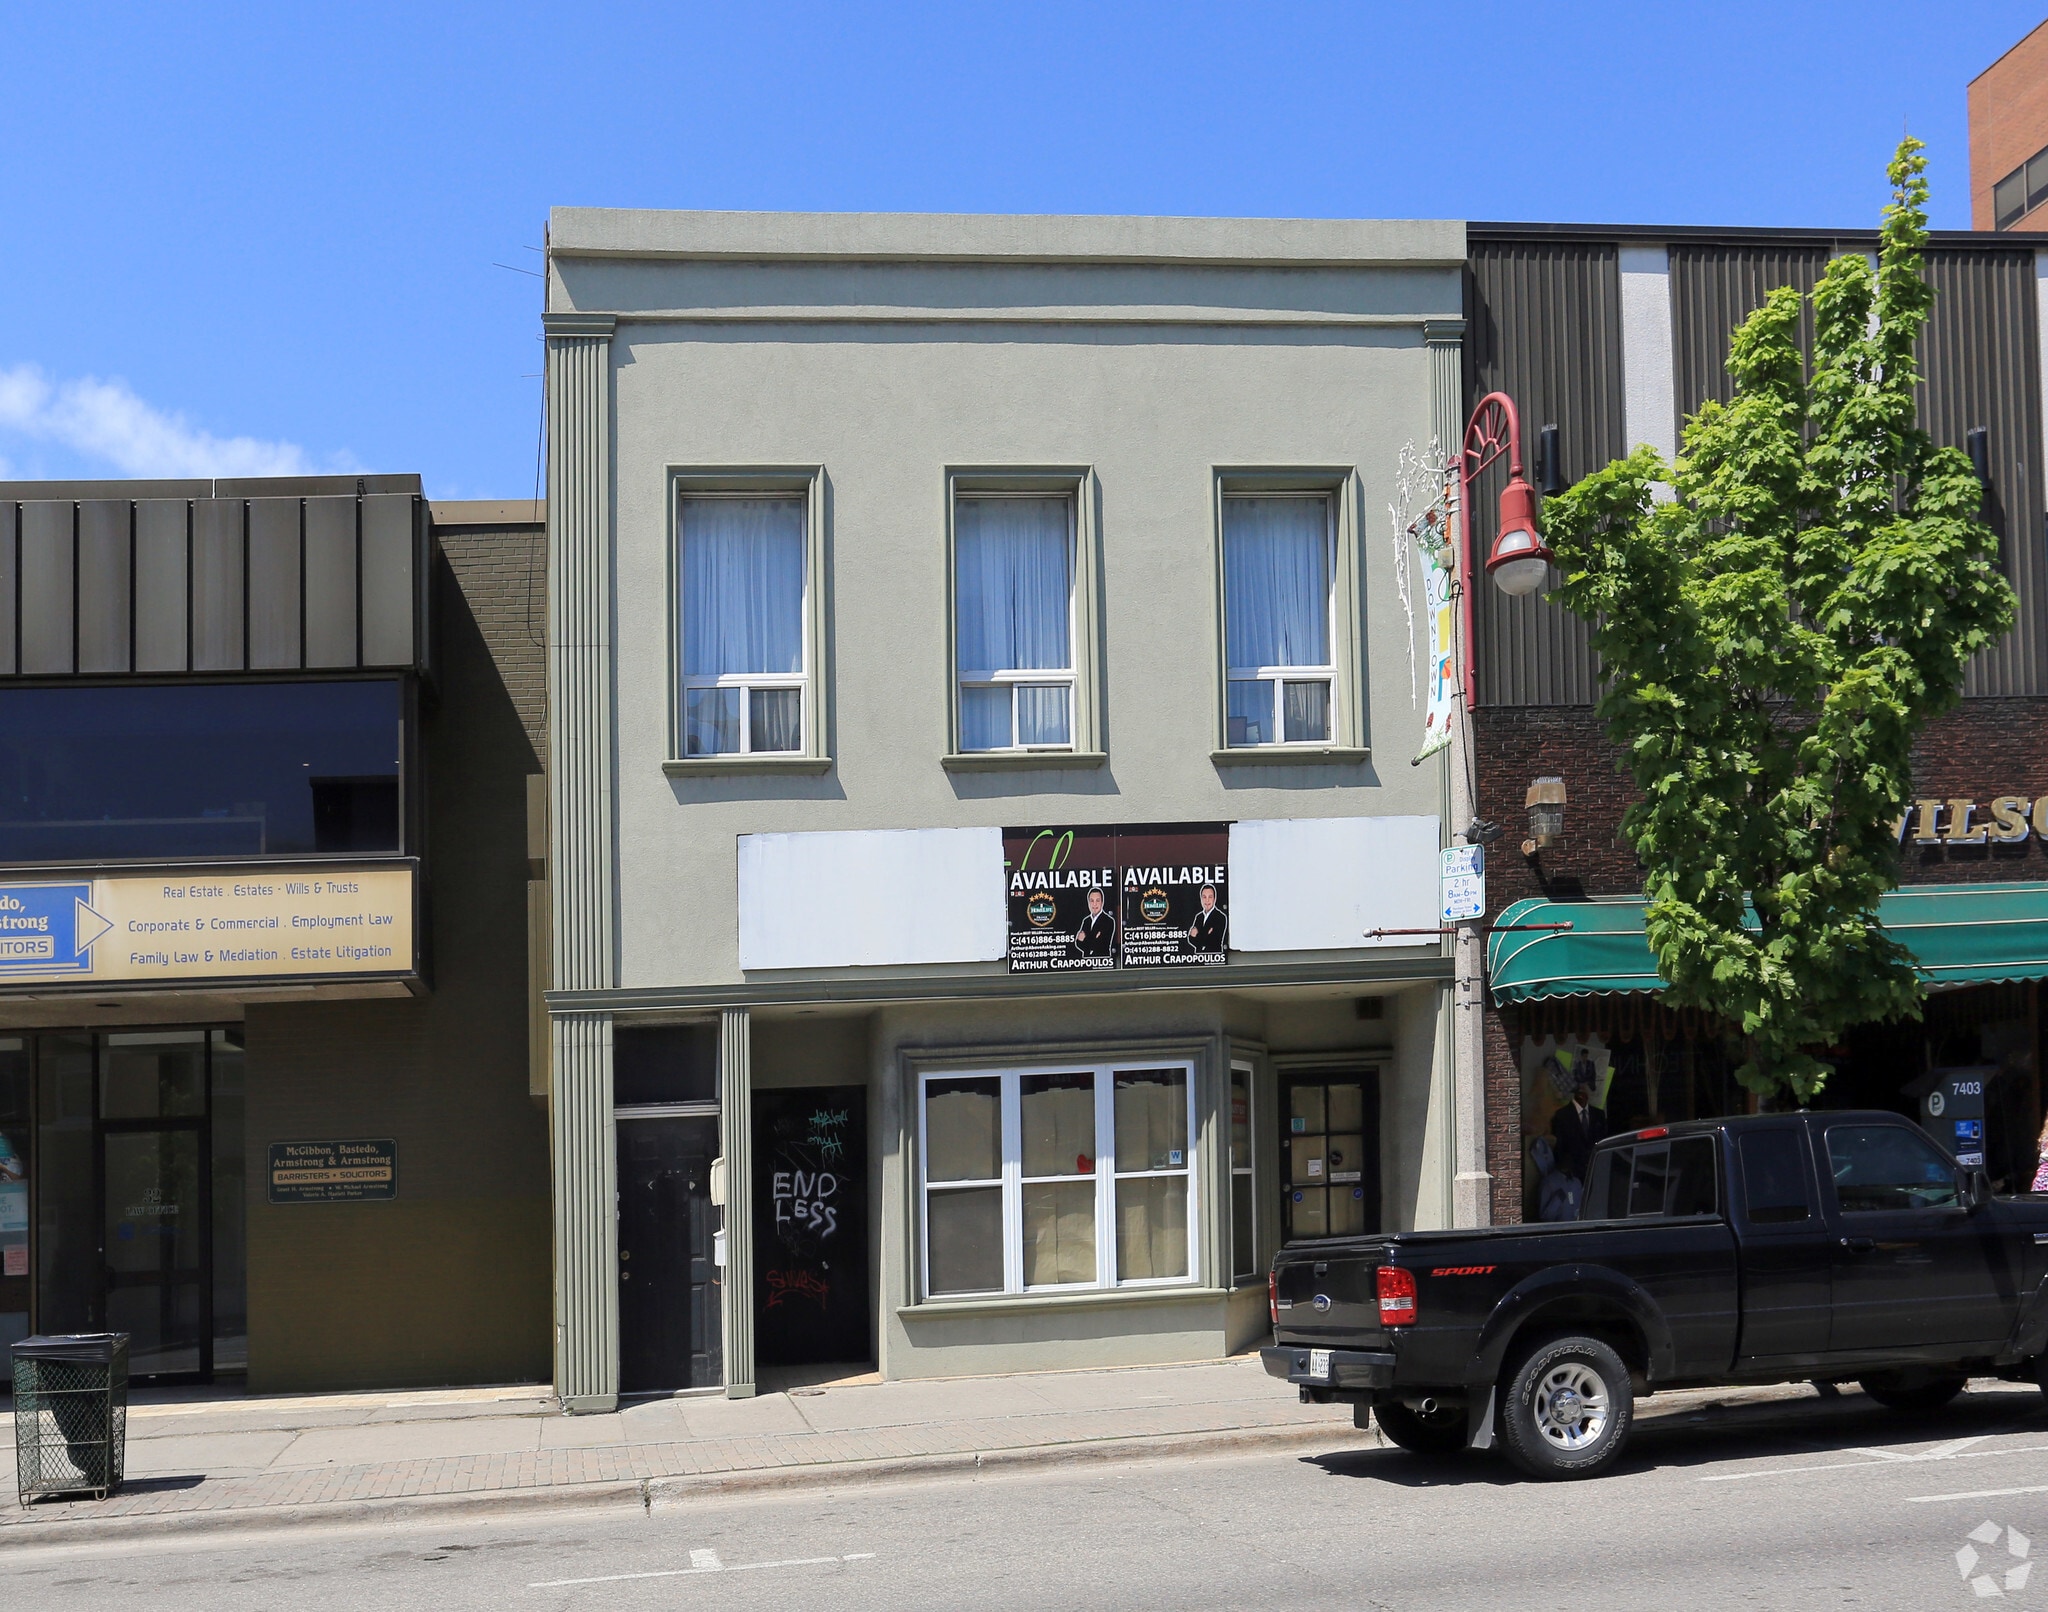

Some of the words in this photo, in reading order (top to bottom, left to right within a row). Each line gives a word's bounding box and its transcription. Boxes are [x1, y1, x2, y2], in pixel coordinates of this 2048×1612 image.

[1426, 578, 1438, 698] DOWNTOWN
[1446, 862, 1478, 875] Parking
[1010, 869, 1113, 890] AVAILABLE
[1124, 866, 1225, 886] AVAILABLE
[1454, 878, 1459, 888] 2
[1462, 878, 1470, 887] hr
[163, 886, 186, 898] Real
[189, 885, 224, 897] Estate
[234, 884, 273, 896] Estates
[285, 883, 310, 895] Wills
[314, 882, 322, 894] &
[326, 882, 359, 894] Trusts
[0, 915, 49, 932] trong
[128, 919, 190, 934] Corporate
[195, 918, 205, 930] &
[210, 917, 279, 930] Commercial
[292, 914, 363, 929] Employment
[368, 913, 393, 925] Law
[1010, 934, 1075, 945] C:(416)886-8885
[1124, 930, 1188, 940] C:(416)886-8885
[0, 941, 48, 955] ITORS
[130, 951, 169, 966] Family
[174, 951, 199, 963] Law
[204, 950, 214, 962] &
[219, 949, 278, 962] Mediation
[291, 947, 331, 960] Estate
[336, 945, 392, 960] Litigation
[1125, 954, 1161, 966] ARTHUR
[1163, 953, 1226, 964] CRAPOPOULOS
[1011, 959, 1049, 971] ARTHUR
[1050, 958, 1114, 969] CRAPOPOULOS
[1952, 1081, 1981, 1095] 7403
[286, 1146, 335, 1156] McGibbon,
[339, 1144, 379, 1154] Bastedo,
[273, 1158, 325, 1168] Armstrong
[328, 1156, 337, 1166] &
[340, 1155, 391, 1165] Armstrong
[277, 1172, 330, 1181] BARRISTERS
[773, 1170, 837, 1200] END
[125, 1206, 145, 1217] LAW
[776, 1199, 837, 1238] LESS
[1430, 1265, 1498, 1278] SPORT
[1521, 1345, 1597, 1406] GOODYEAR
[1553, 1410, 1627, 1469] WRANGLER
